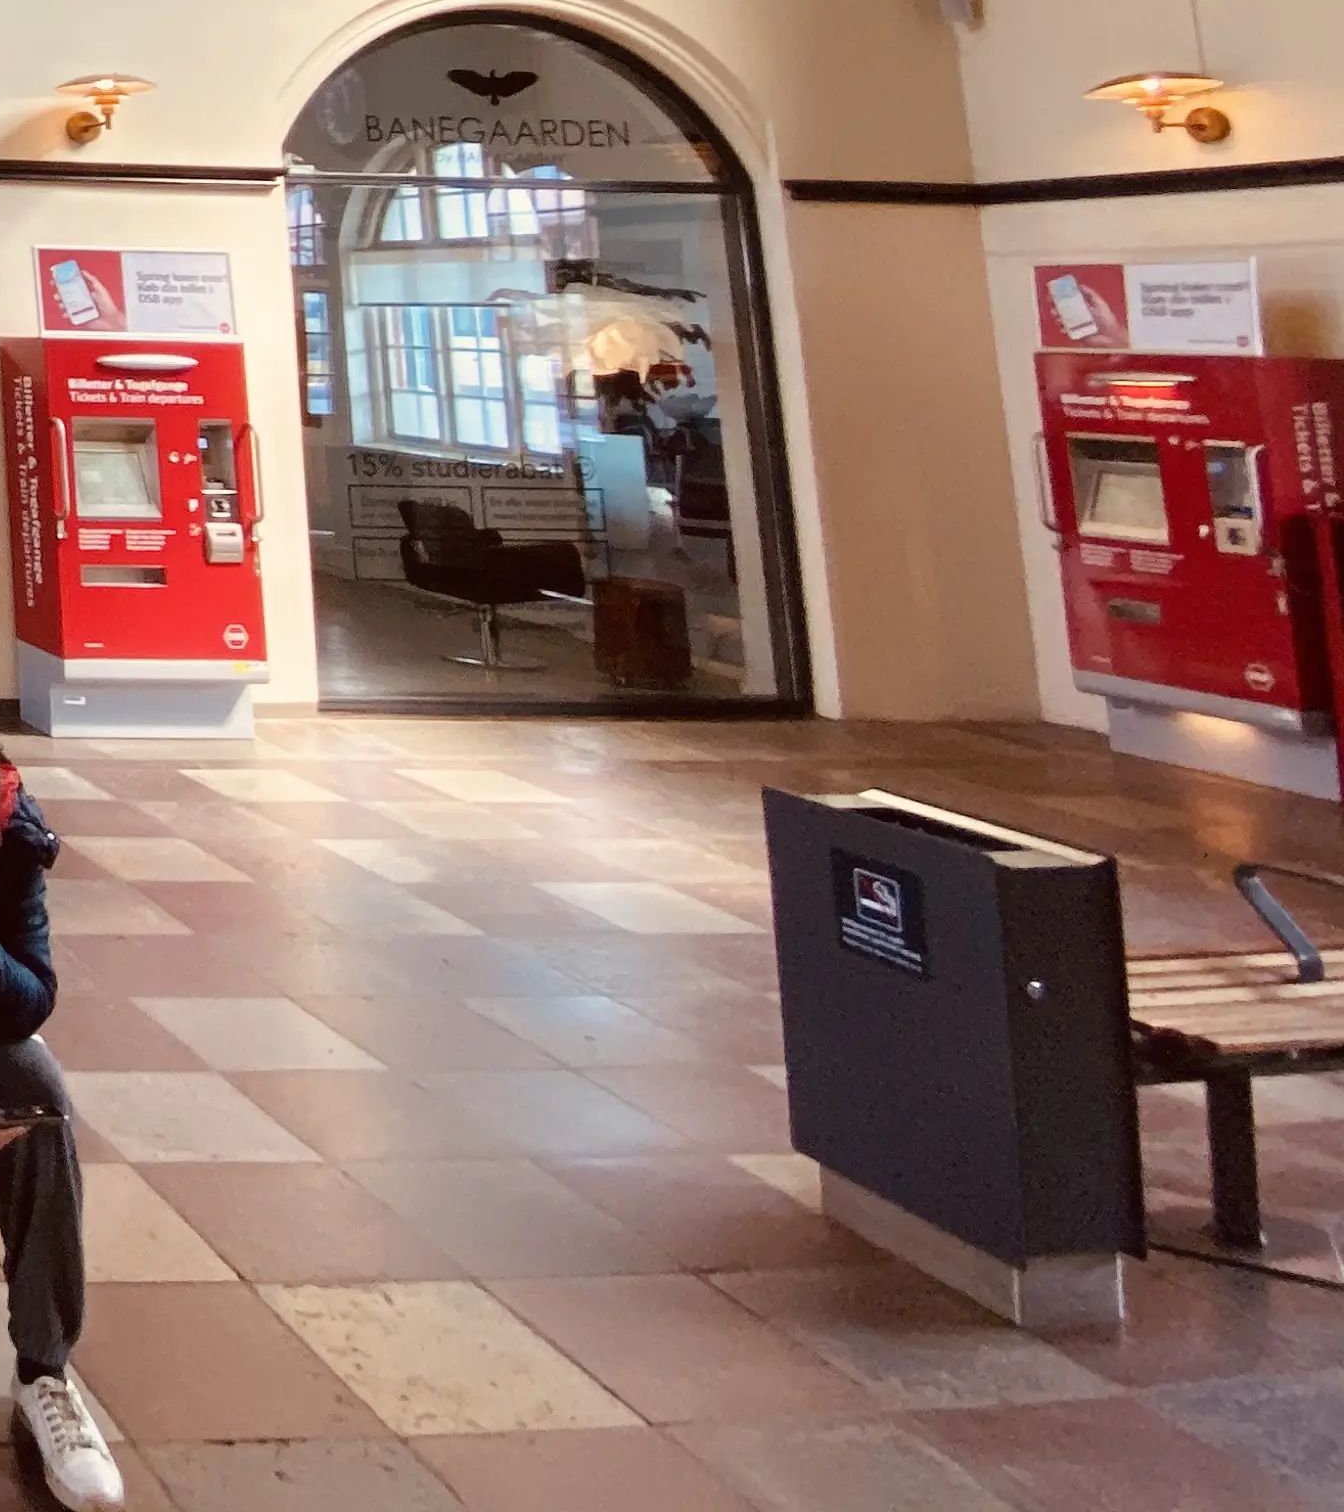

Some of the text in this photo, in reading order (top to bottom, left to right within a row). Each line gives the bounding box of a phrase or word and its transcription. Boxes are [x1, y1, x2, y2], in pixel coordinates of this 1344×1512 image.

[364, 114, 630, 147] BANEGAARDEN
[13, 376, 24, 436] Tickets
[109, 392, 118, 403] &
[346, 452, 564, 480] 15% studierabat
